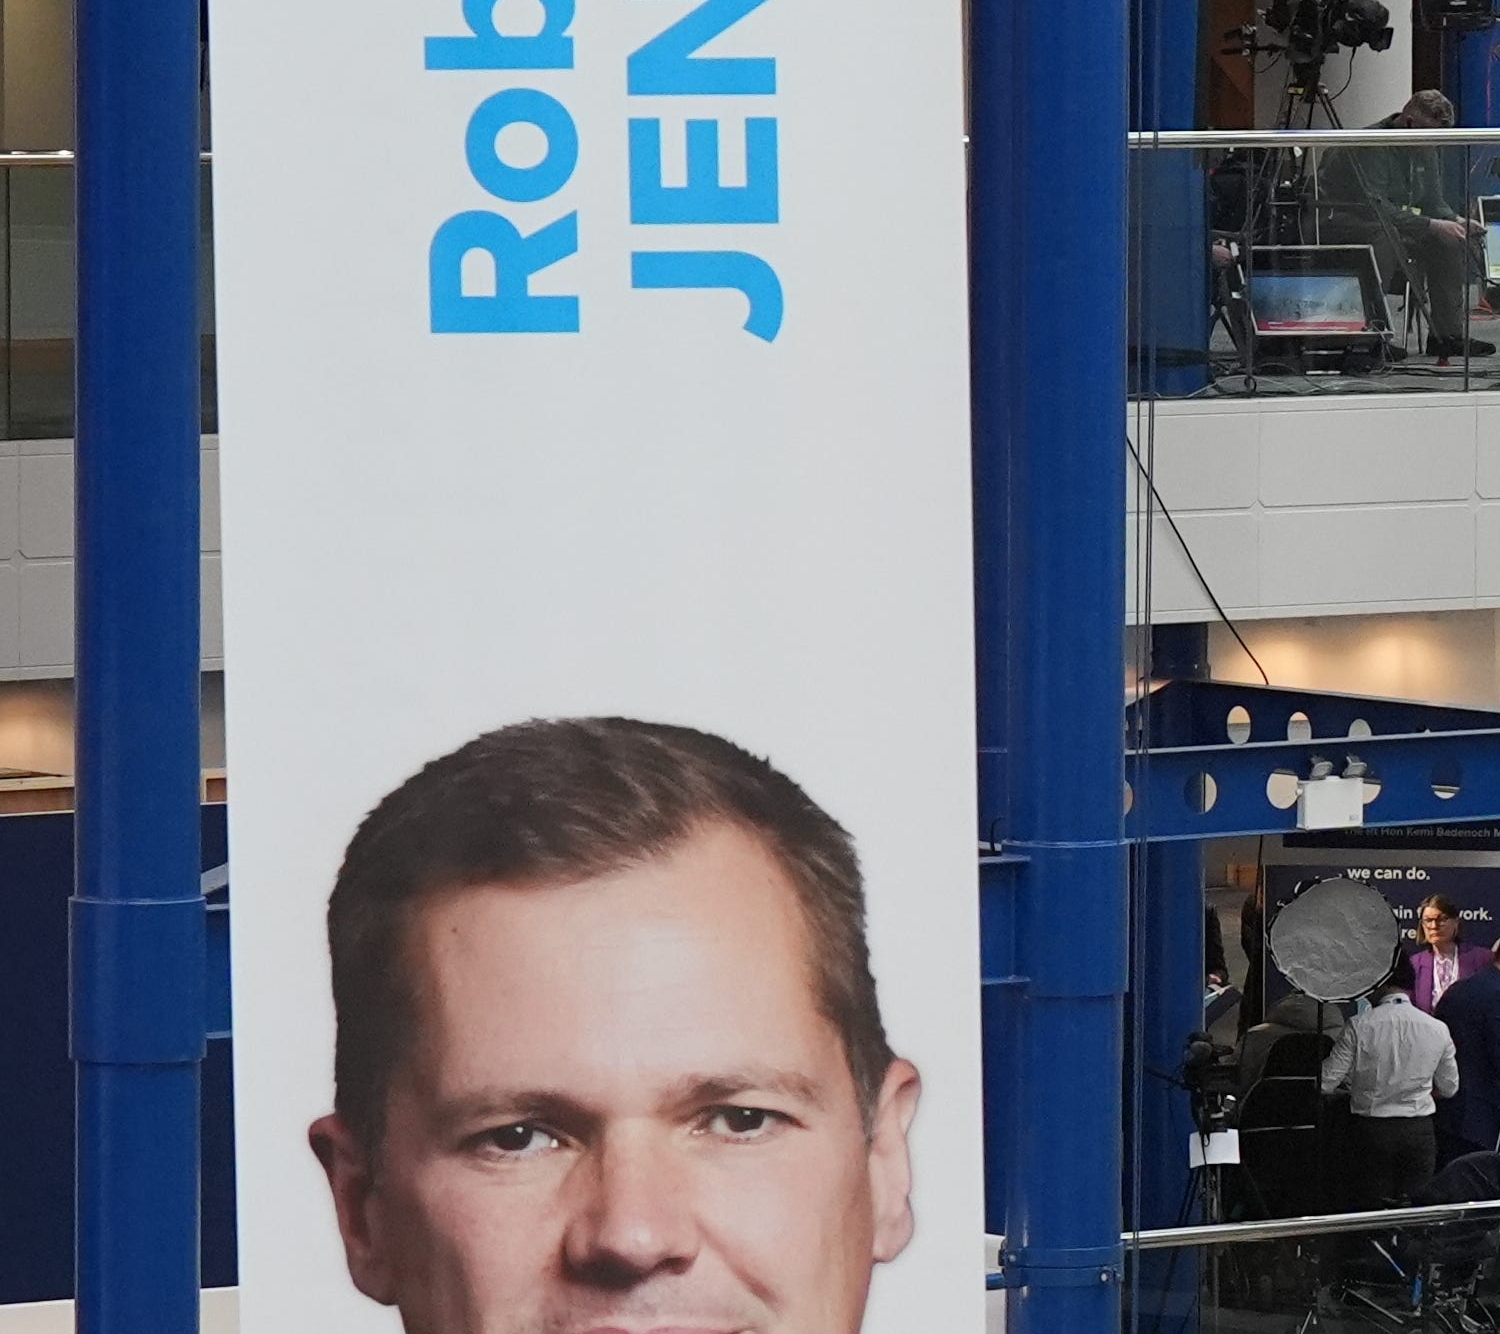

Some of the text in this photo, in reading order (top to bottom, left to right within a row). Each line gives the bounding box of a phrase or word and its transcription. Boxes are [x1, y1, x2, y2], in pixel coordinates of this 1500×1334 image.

[1406, 826, 1434, 837] Kemi
[1347, 866, 1431, 880] we can do.
[1459, 907, 1493, 921] ork.
